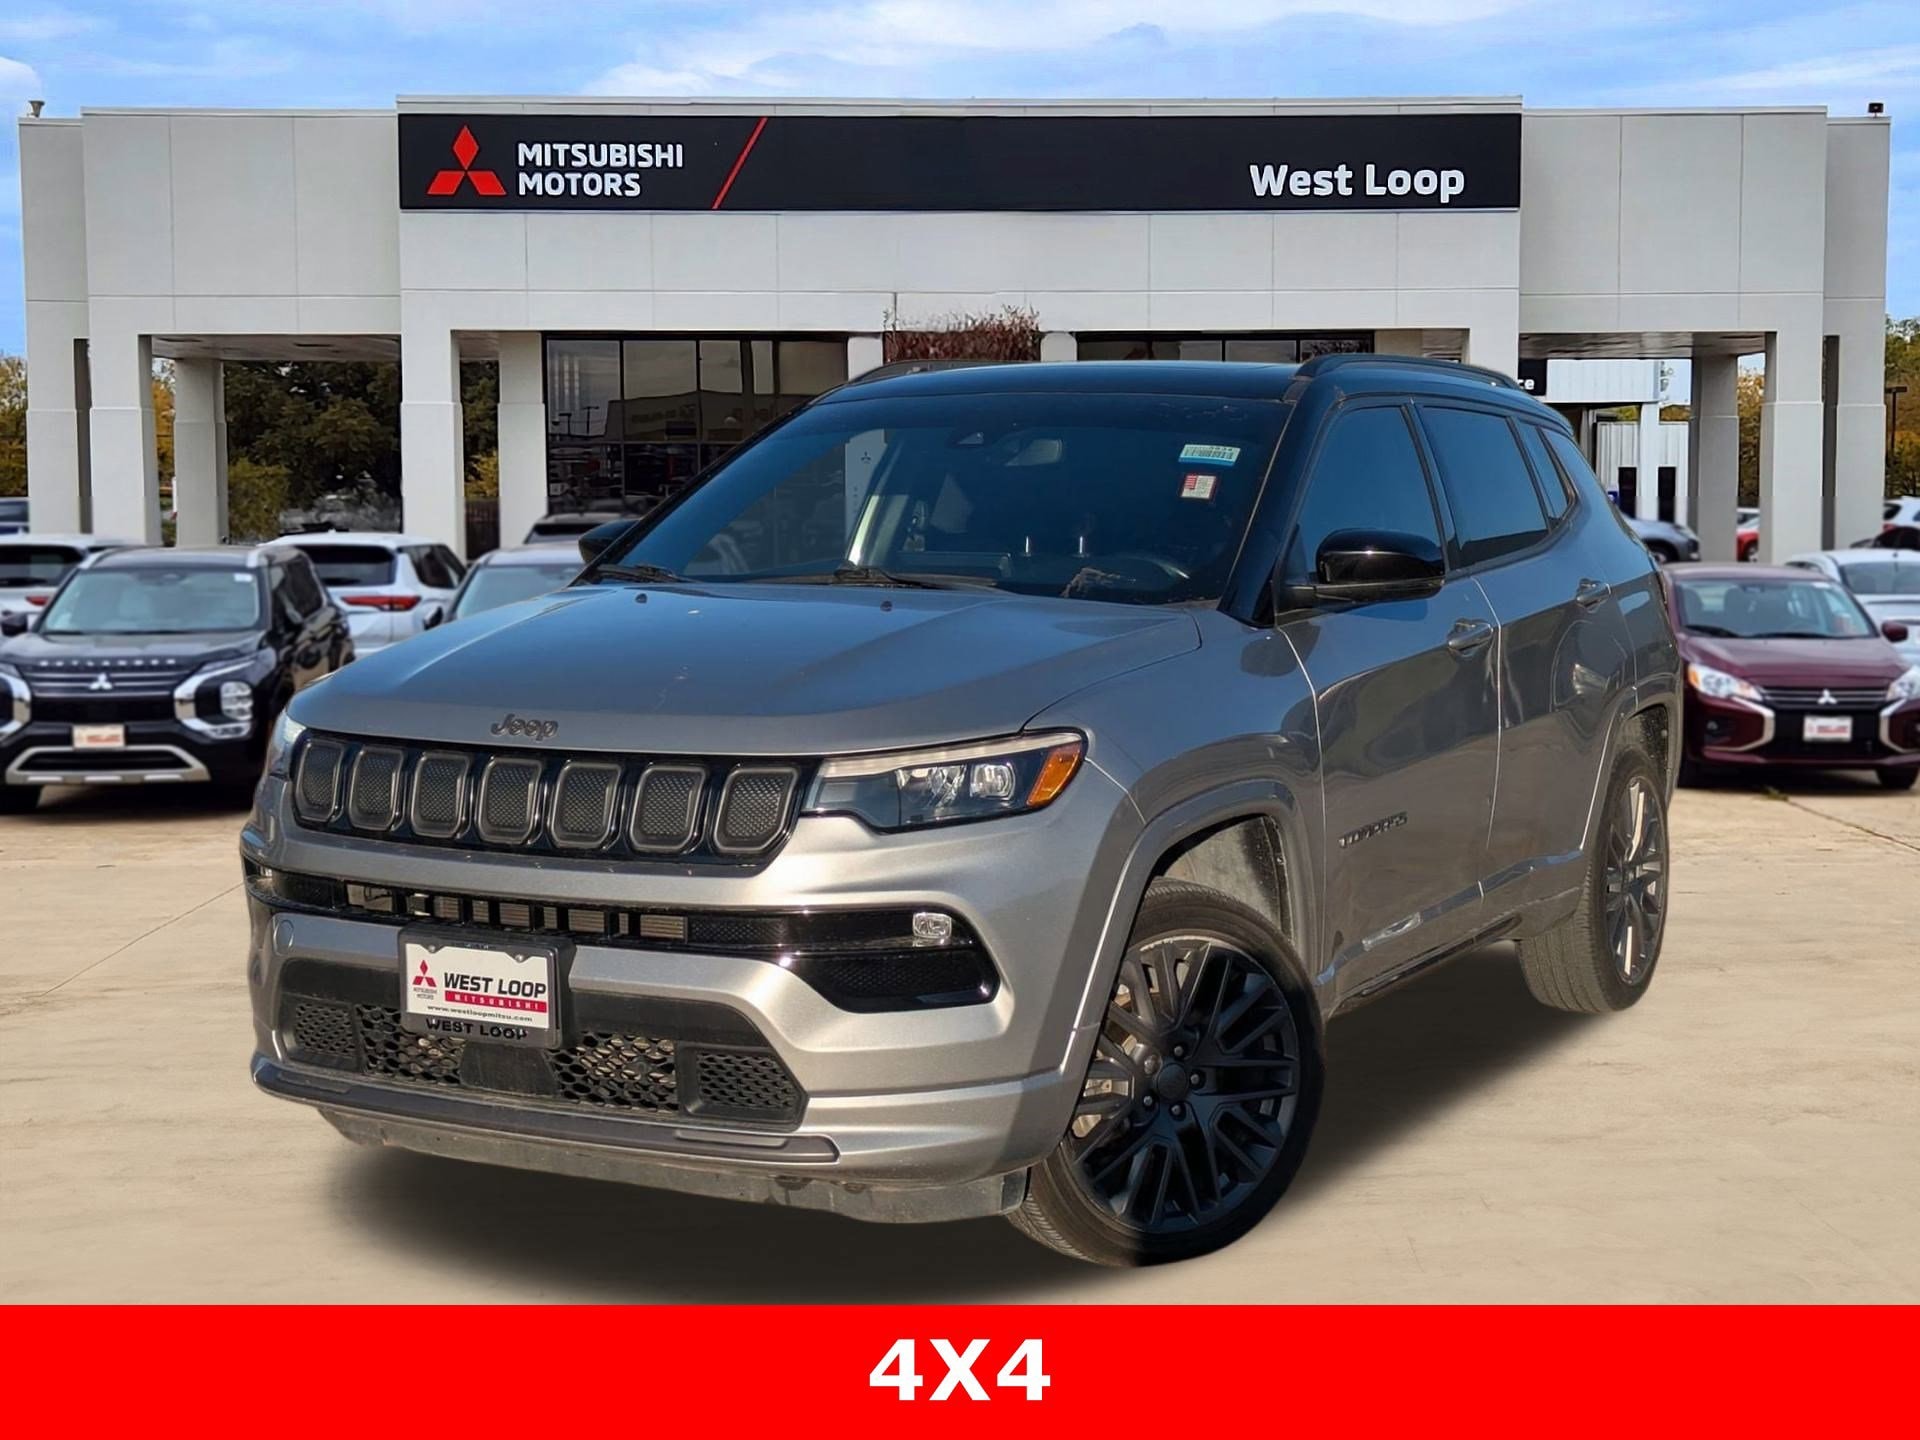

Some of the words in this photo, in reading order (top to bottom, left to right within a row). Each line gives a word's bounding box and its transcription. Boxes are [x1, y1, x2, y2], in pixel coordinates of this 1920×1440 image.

[517, 143, 684, 169] MITSUBISHI
[517, 172, 641, 197] MOTORS
[1249, 164, 1353, 197] West
[1365, 164, 1466, 204] Loop
[490, 713, 559, 742] Jeep
[444, 972, 493, 993] WEST
[497, 978, 547, 998] LOOP
[427, 1005, 533, 1022] www.westloopmitsu.com
[454, 994, 540, 1010] MITSUBISHI
[425, 1018, 474, 1035] WEST
[479, 1024, 528, 1040] LOOP
